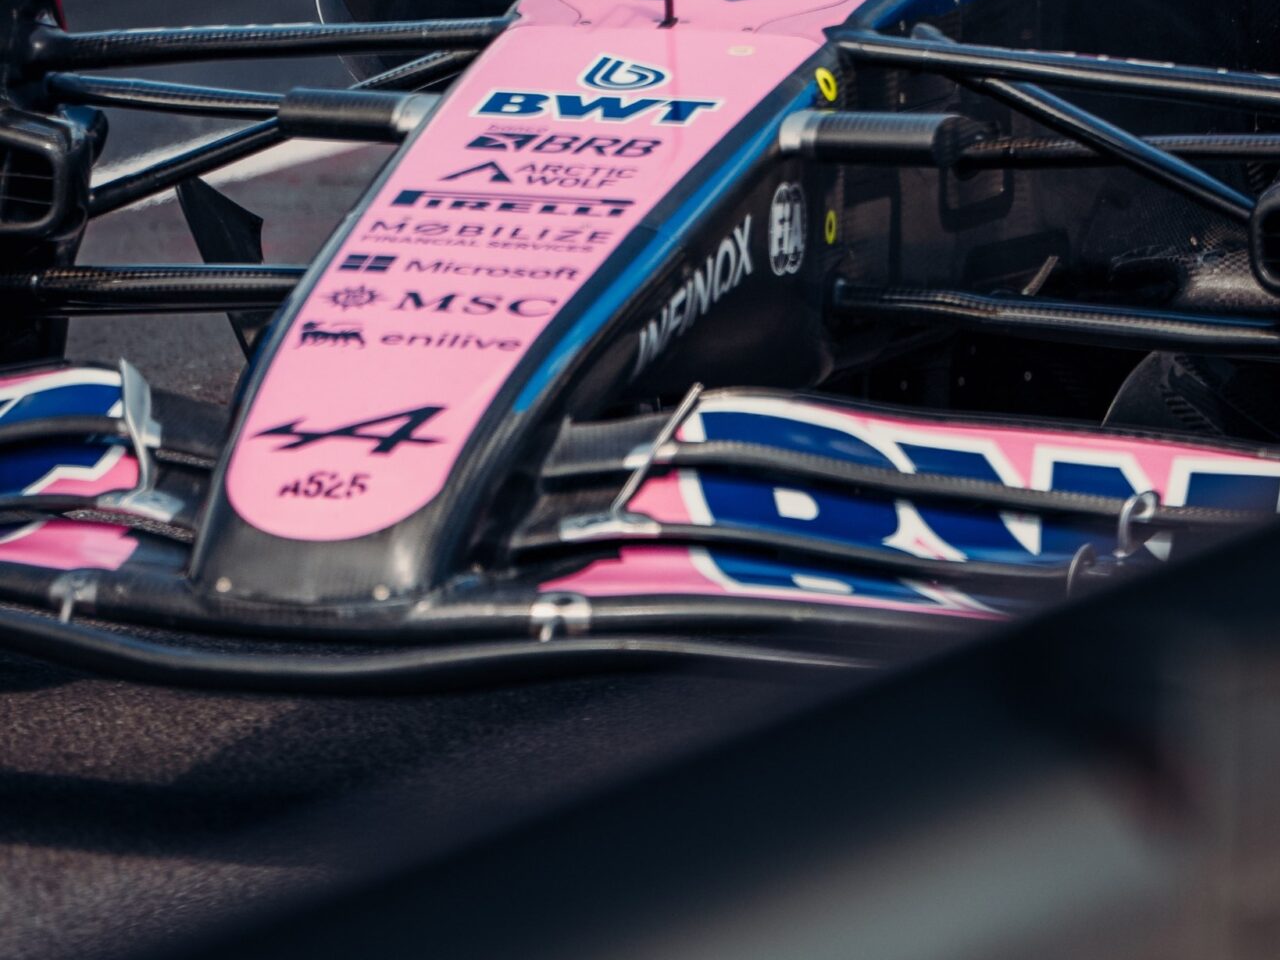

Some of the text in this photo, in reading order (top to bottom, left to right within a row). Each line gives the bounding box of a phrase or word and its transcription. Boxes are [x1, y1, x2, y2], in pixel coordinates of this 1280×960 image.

[476, 91, 718, 126] BWT
[531, 134, 663, 158] BRB
[514, 161, 639, 179] ARCTIC
[525, 175, 617, 190] WOLF
[389, 190, 636, 218] PIRELLI
[404, 259, 580, 281] Microsoft
[391, 290, 560, 318] MSC
[632, 213, 753, 380] INFINOX
[379, 334, 522, 351] enilive
